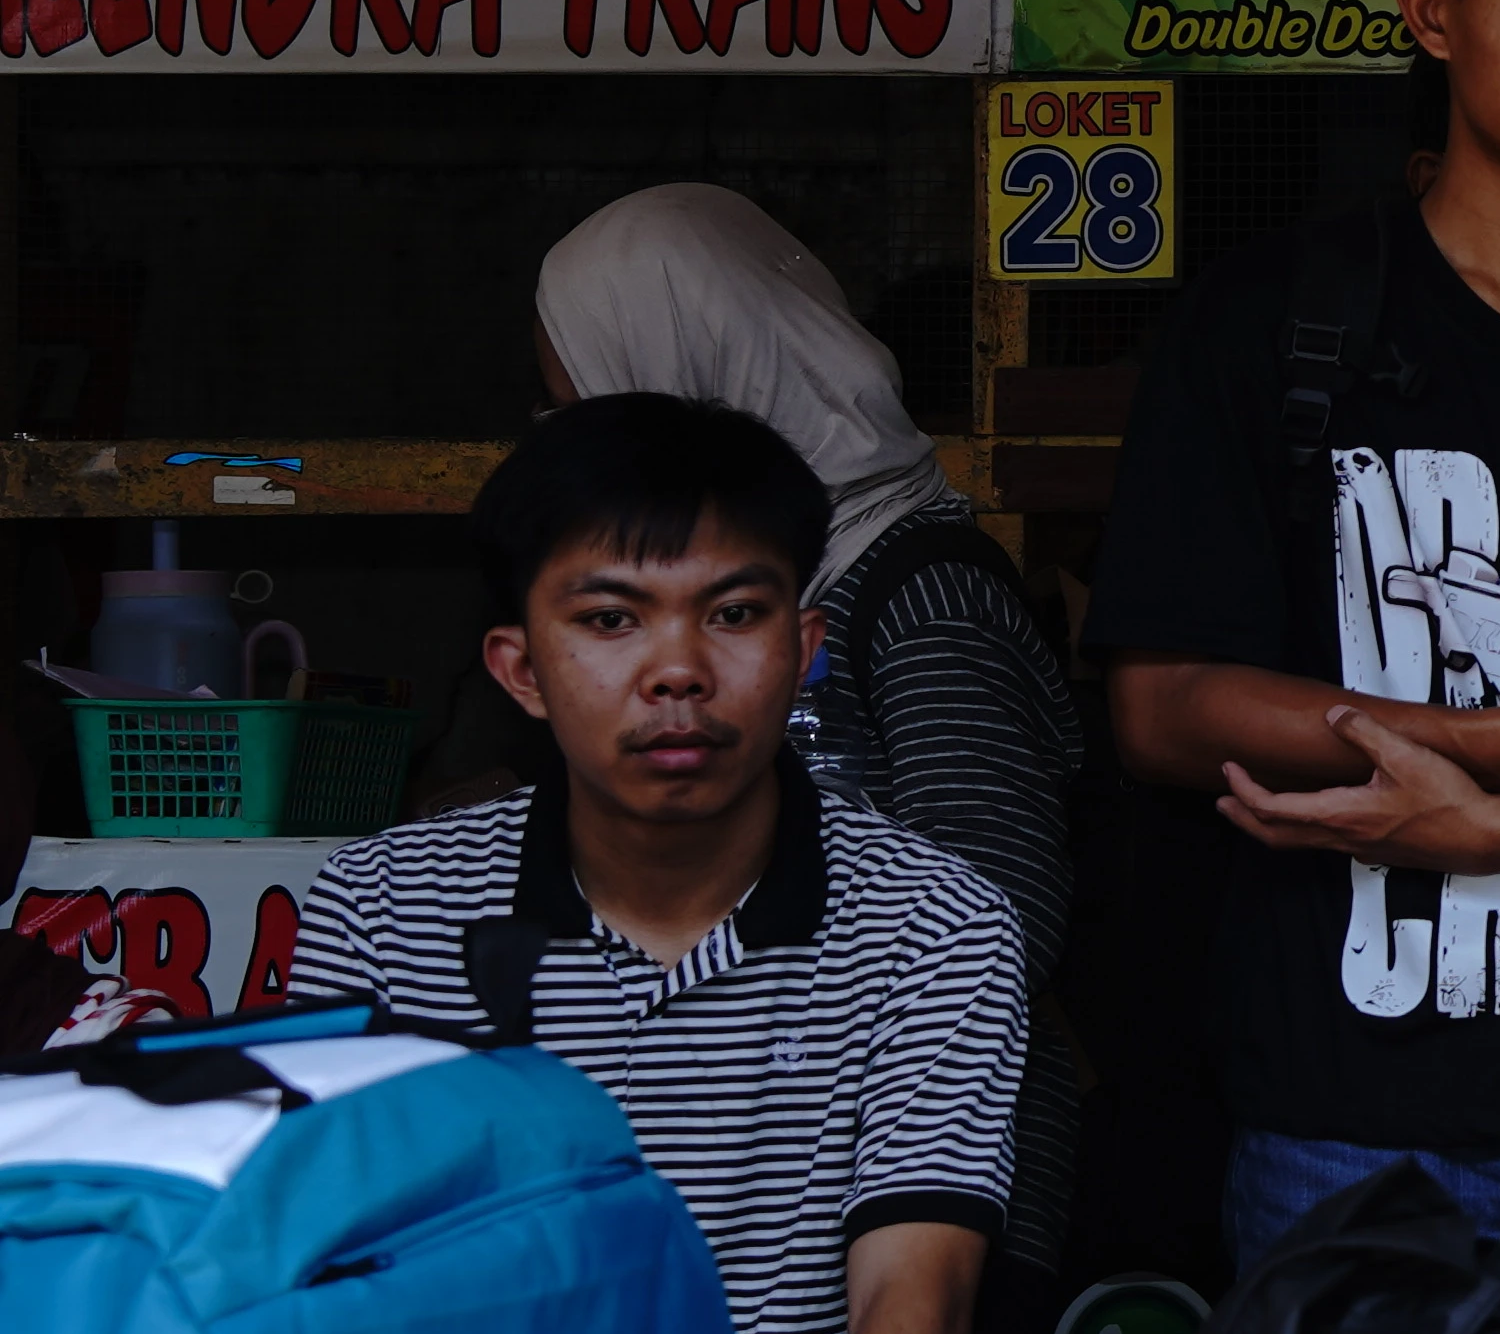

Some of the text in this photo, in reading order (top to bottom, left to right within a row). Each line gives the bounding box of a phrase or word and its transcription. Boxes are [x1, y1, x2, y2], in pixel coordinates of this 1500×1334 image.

[1131, 5, 1308, 53] Double
[1001, 92, 1160, 138] LOKET
[1002, 145, 1162, 271] 28
